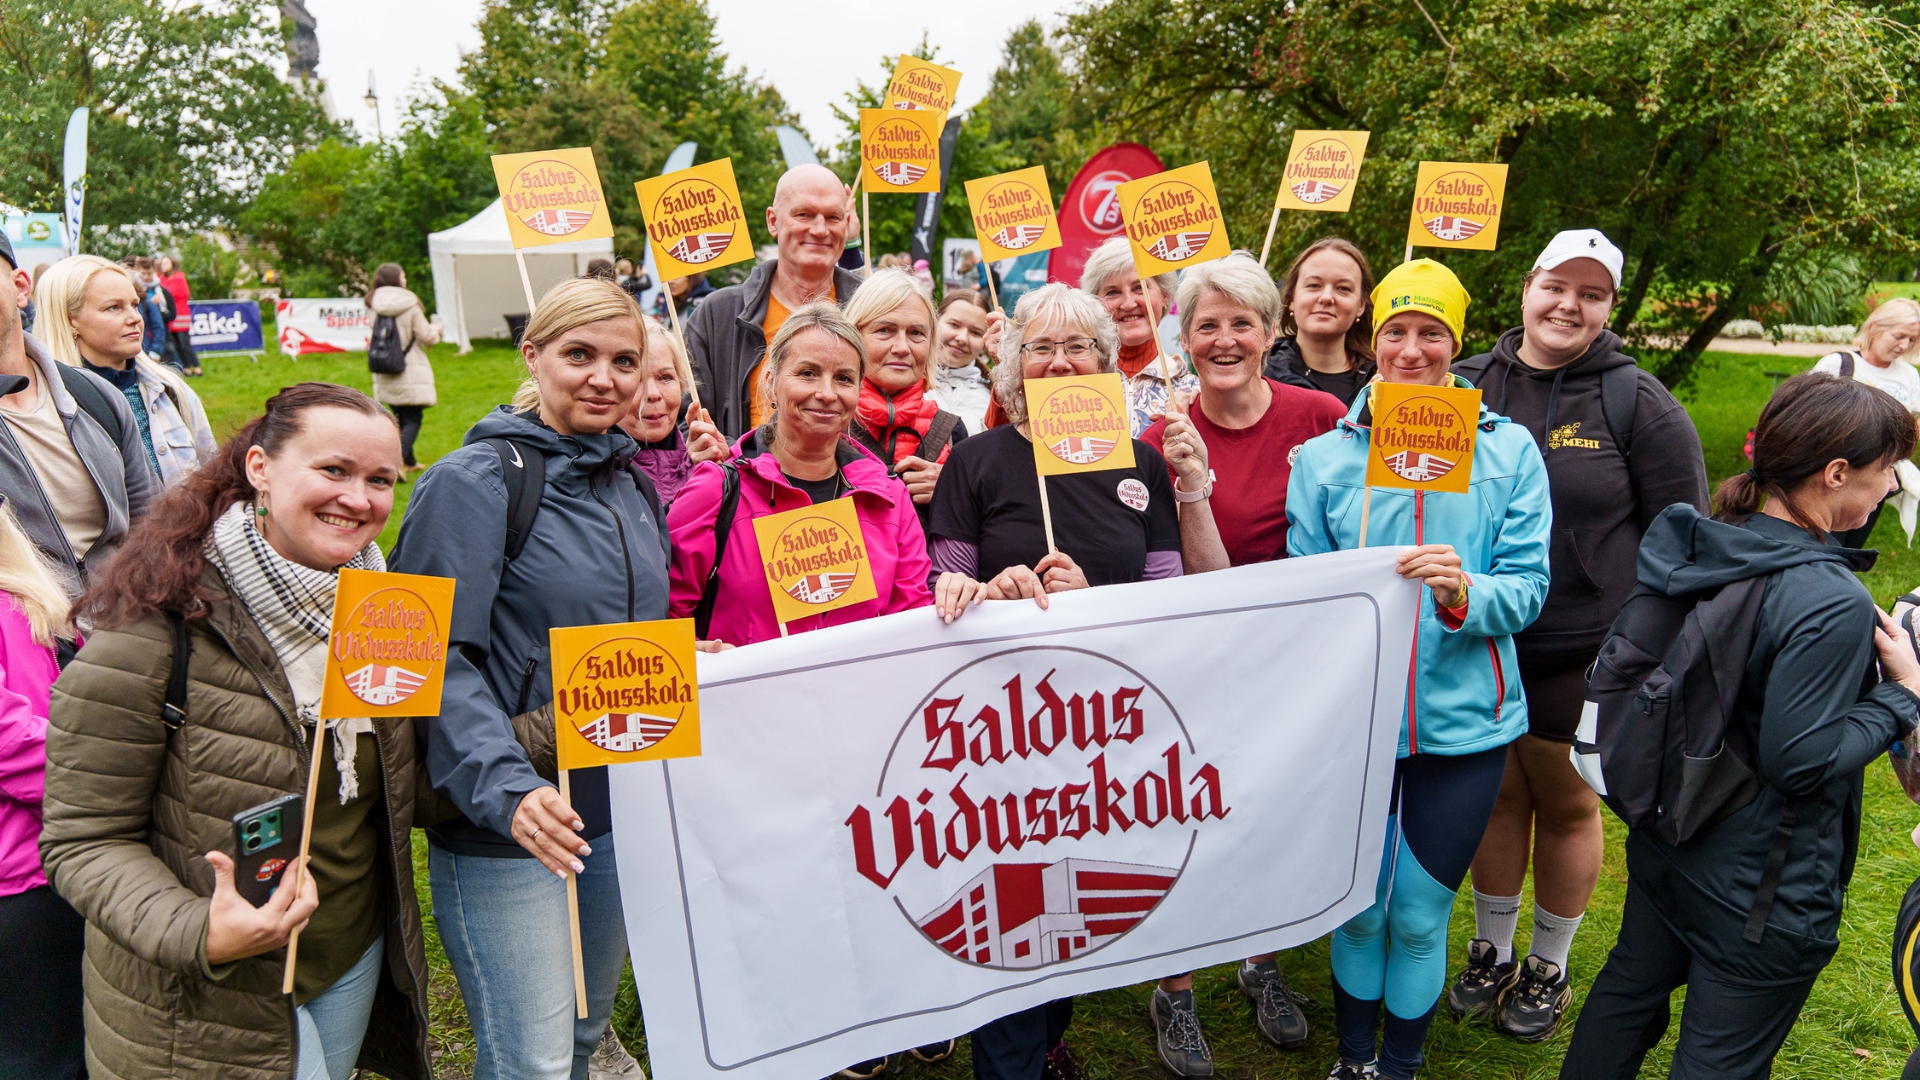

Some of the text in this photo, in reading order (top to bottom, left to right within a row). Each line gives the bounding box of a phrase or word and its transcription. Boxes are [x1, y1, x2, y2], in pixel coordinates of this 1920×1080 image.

[907, 72, 943, 93] Saldus
[891, 82, 948, 111] Vidusskola
[878, 125, 920, 142] Saldus
[863, 143, 936, 161] Vidusskola
[1304, 145, 1347, 161] Saldus
[521, 167, 576, 189] Saldus
[1287, 162, 1355, 180] Vidusskola
[504, 184, 601, 213] Vidusskola
[663, 187, 716, 214] Saldus
[988, 188, 1032, 209] Saldus
[1435, 178, 1484, 196] Saldus
[1143, 189, 1195, 215] Saldus
[1416, 196, 1498, 216] Vidusskola
[649, 201, 741, 243] Vidusskola
[975, 201, 1051, 232] Vidusskola
[1128, 202, 1219, 242] Vidusskola
[1050, 393, 1103, 415] Saldus
[1396, 405, 1455, 428] Saldus
[1032, 411, 1126, 439] Vidusskola
[1374, 426, 1471, 452] Vidusskola
[1562, 438, 1600, 449] MEHI
[782, 525, 838, 553] Saldus
[767, 541, 864, 583] Vidusskola
[360, 599, 427, 630] Saldus
[334, 629, 443, 662] Vidusskola
[586, 648, 664, 680] Saldus
[558, 675, 694, 717] Vidusskola
[920, 668, 1145, 772] Saldus
[844, 741, 1232, 890] Vidusskola
